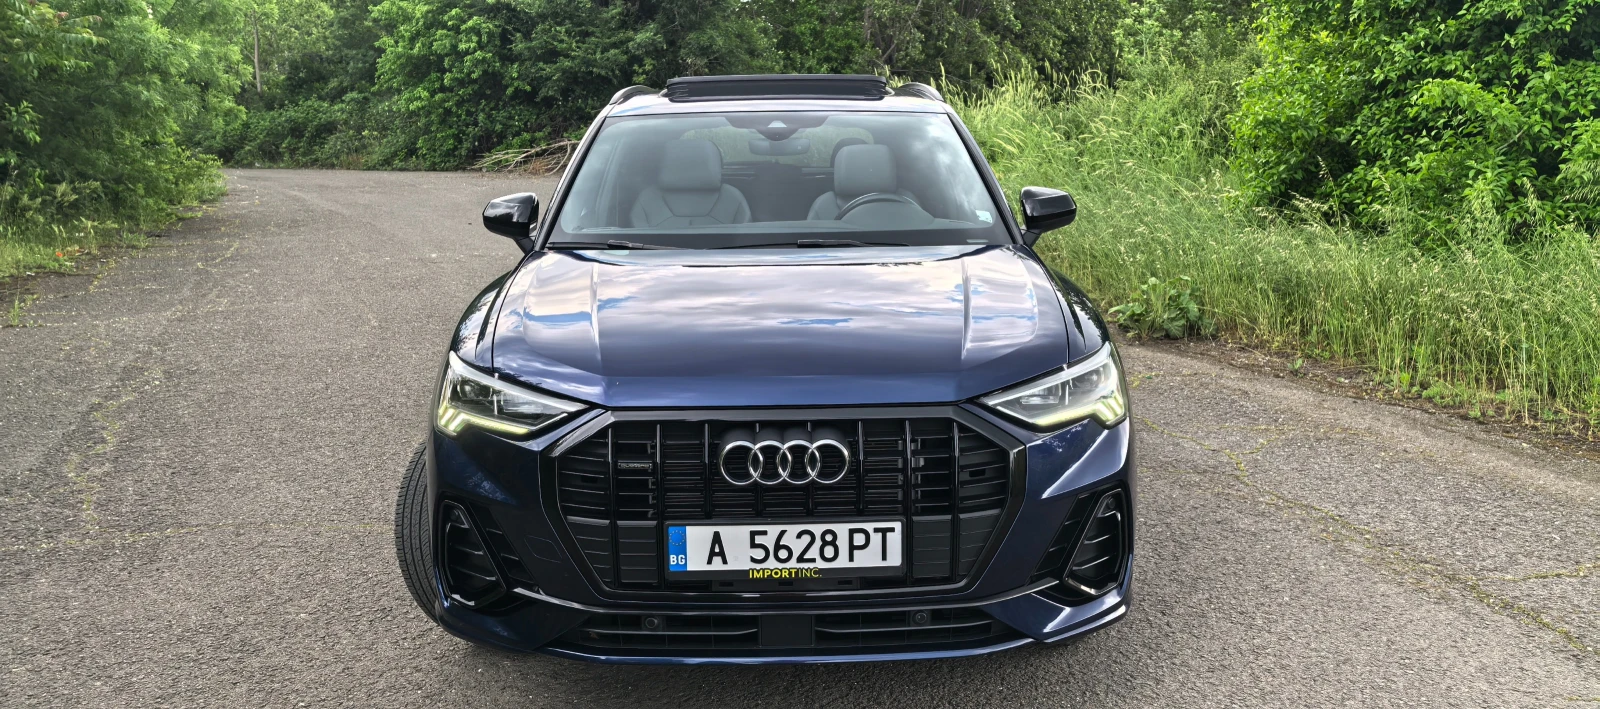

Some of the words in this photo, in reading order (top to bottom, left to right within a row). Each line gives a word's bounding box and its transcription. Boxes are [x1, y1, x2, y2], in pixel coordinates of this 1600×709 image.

[706, 530, 729, 565] A
[749, 528, 840, 564] 5628
[848, 527, 896, 563] PT
[669, 554, 686, 565] BG
